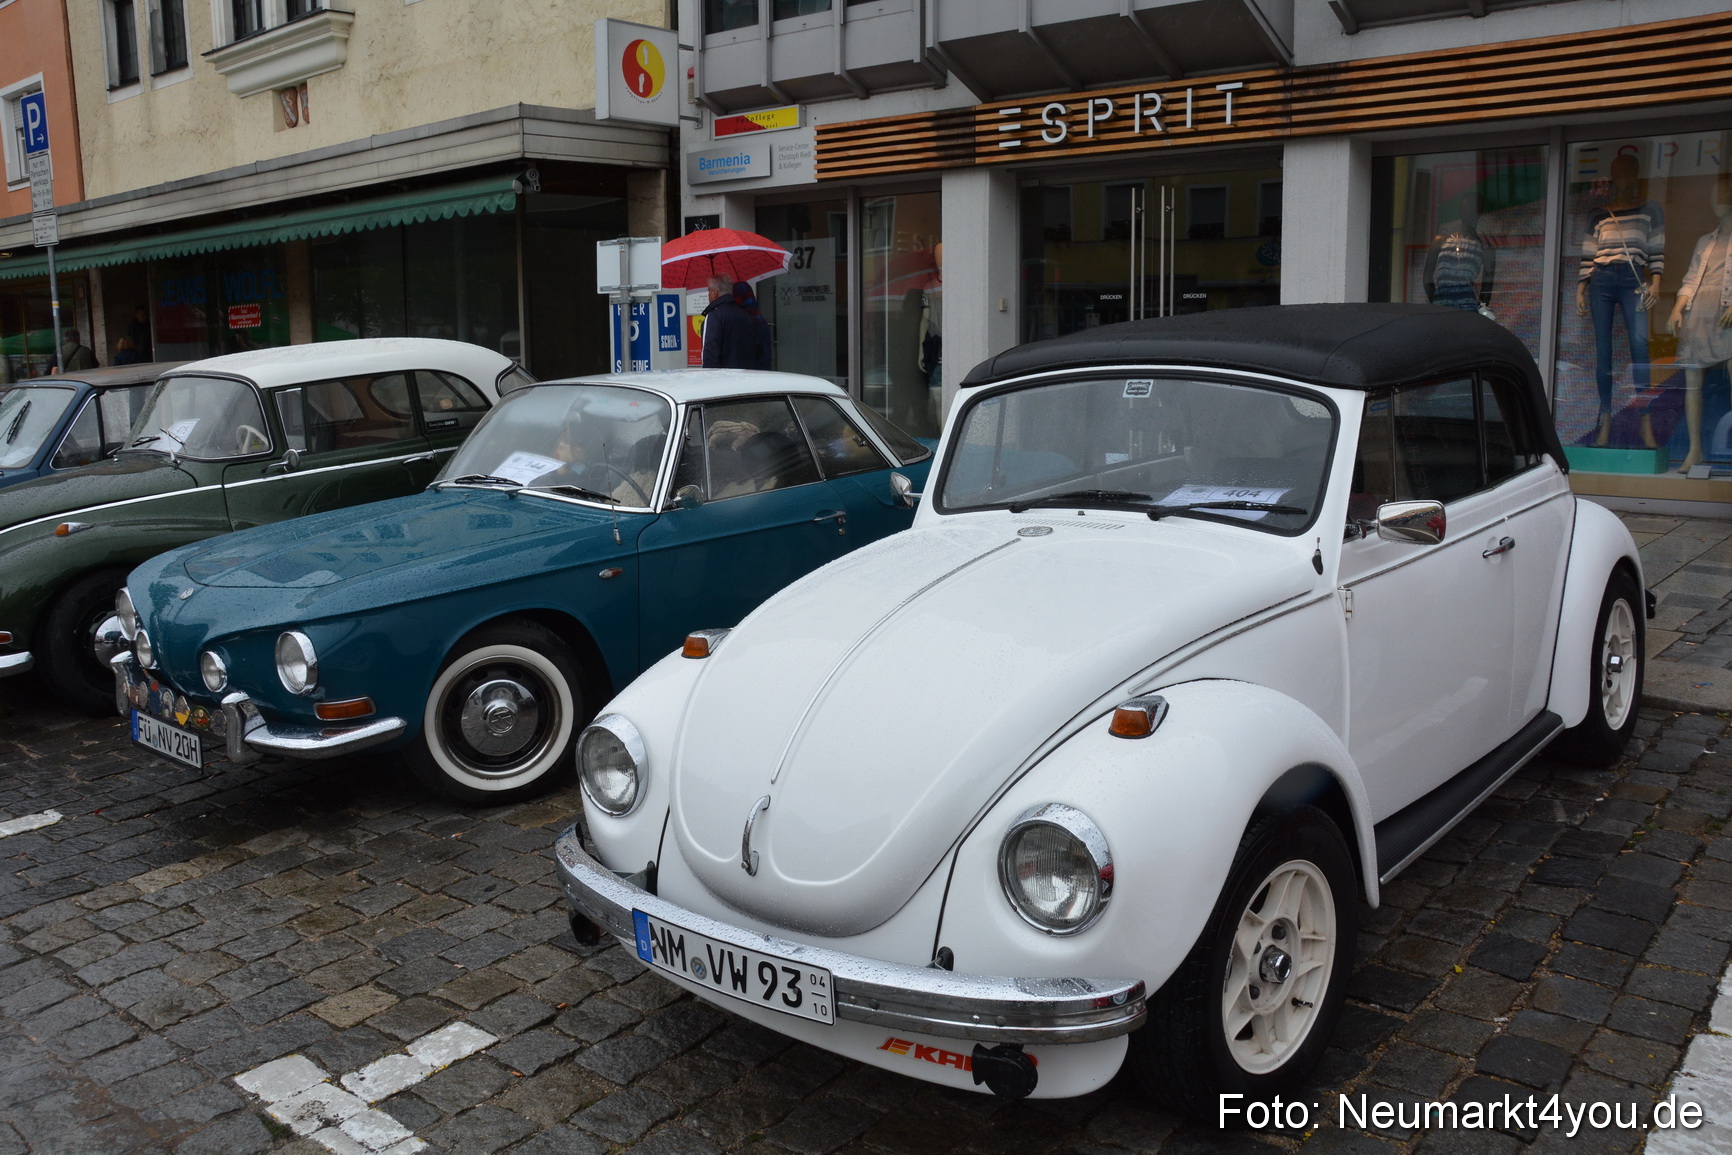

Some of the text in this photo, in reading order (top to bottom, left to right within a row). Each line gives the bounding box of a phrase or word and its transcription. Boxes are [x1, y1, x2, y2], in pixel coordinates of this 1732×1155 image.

[26, 102, 41, 146] P
[998, 81, 1244, 148] ESPRIT
[698, 152, 751, 171] Barmenia
[793, 246, 815, 270] 37
[159, 275, 207, 307] JEANS
[1099, 293, 1123, 301] DRÜCKEN
[1182, 292, 1207, 300] DRÜCKEN
[663, 301, 677, 328] P
[1223, 489, 1261, 498] 404
[137, 715, 198, 764] FÜ NV 20H
[648, 921, 803, 1009] NM VW 93
[810, 972, 826, 989] 04
[812, 1001, 828, 1017] 10
